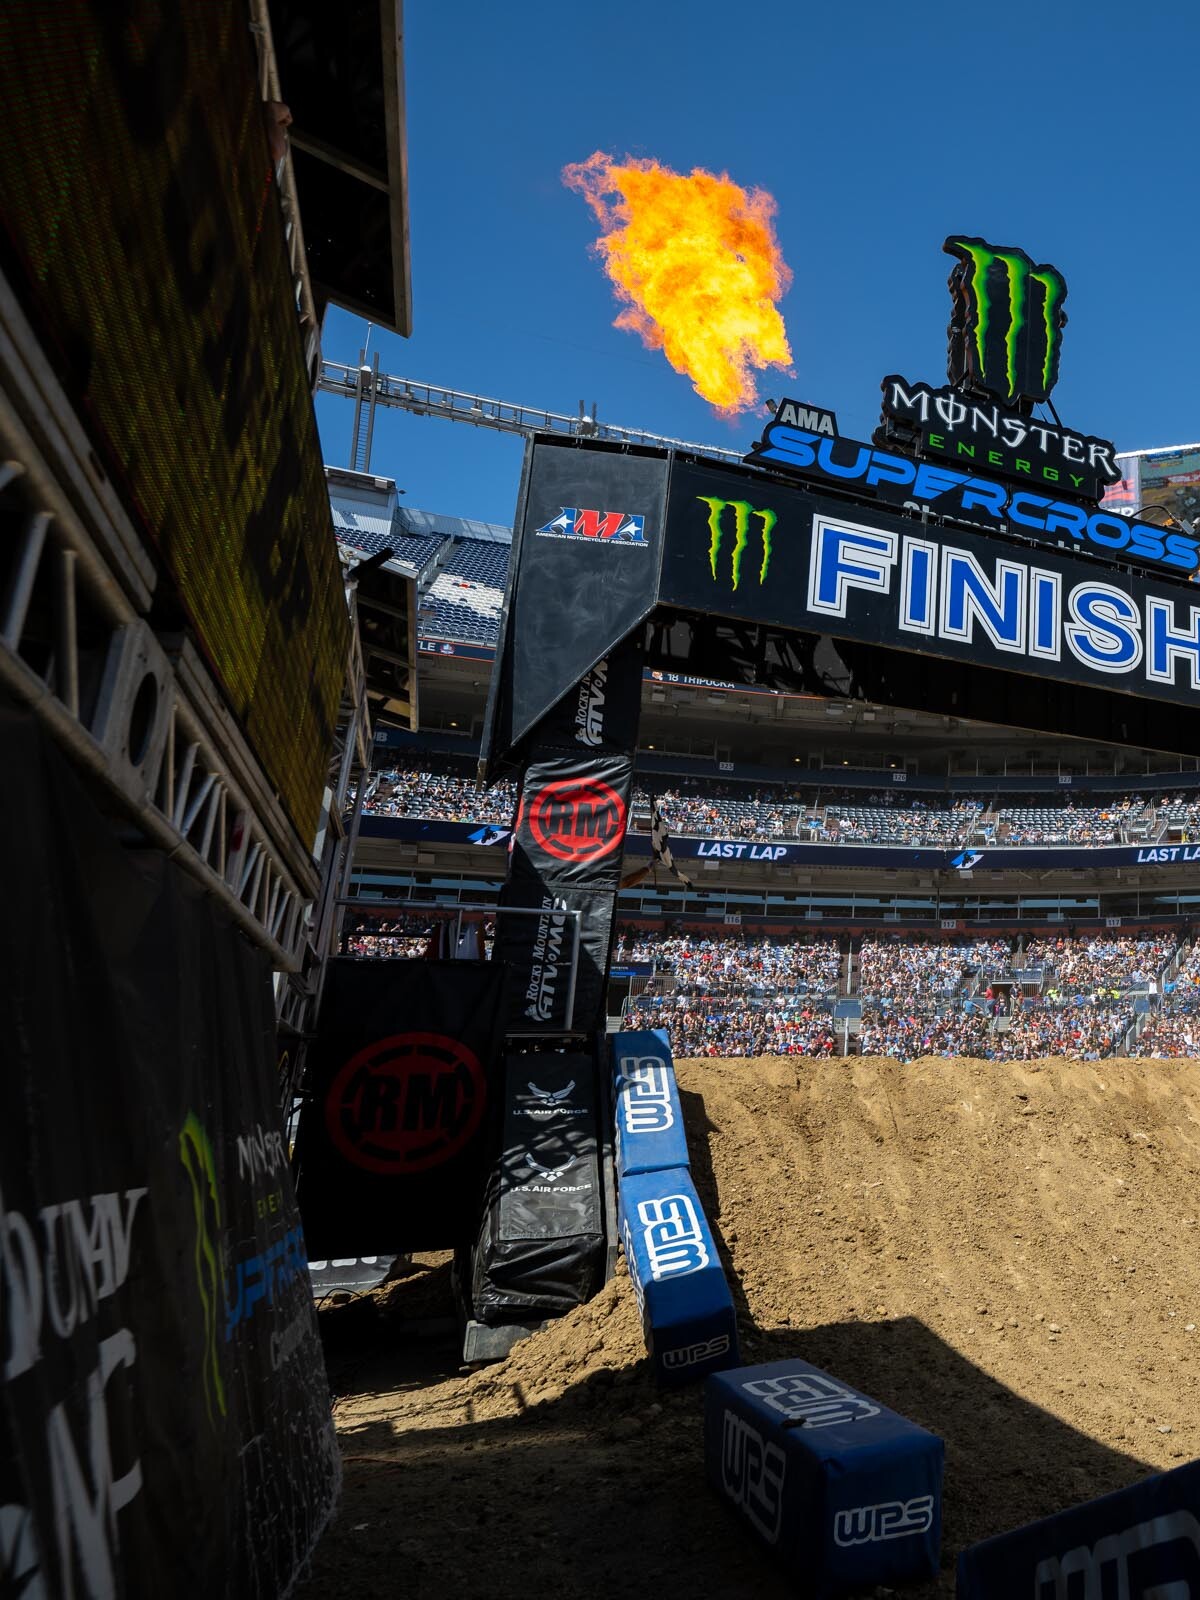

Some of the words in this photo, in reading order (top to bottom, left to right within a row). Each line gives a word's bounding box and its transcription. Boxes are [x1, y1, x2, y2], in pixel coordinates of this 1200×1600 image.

[780, 404, 835, 436] AMA
[892, 382, 1116, 477] MONSTER
[929, 433, 1085, 488] ENERGY
[768, 426, 1200, 570] SUPERCROSS
[535, 506, 650, 543] AMA
[536, 532, 567, 540] AMERICAN
[567, 535, 611, 544] MOTORCYCLIST
[611, 539, 649, 548] ASSOCIATION
[575, 687, 590, 726] ROCKY
[698, 842, 746, 859] LAST
[750, 845, 787, 861] LAP
[1137, 848, 1180, 863] LAST
[525, 964, 543, 1002] ROCKY
[620, 1056, 675, 1135] WPS
[552, 1183, 593, 1192] FORCE
[637, 1194, 710, 1282] WPS
[663, 1335, 730, 1369] WPS
[833, 1494, 935, 1547] WPS
